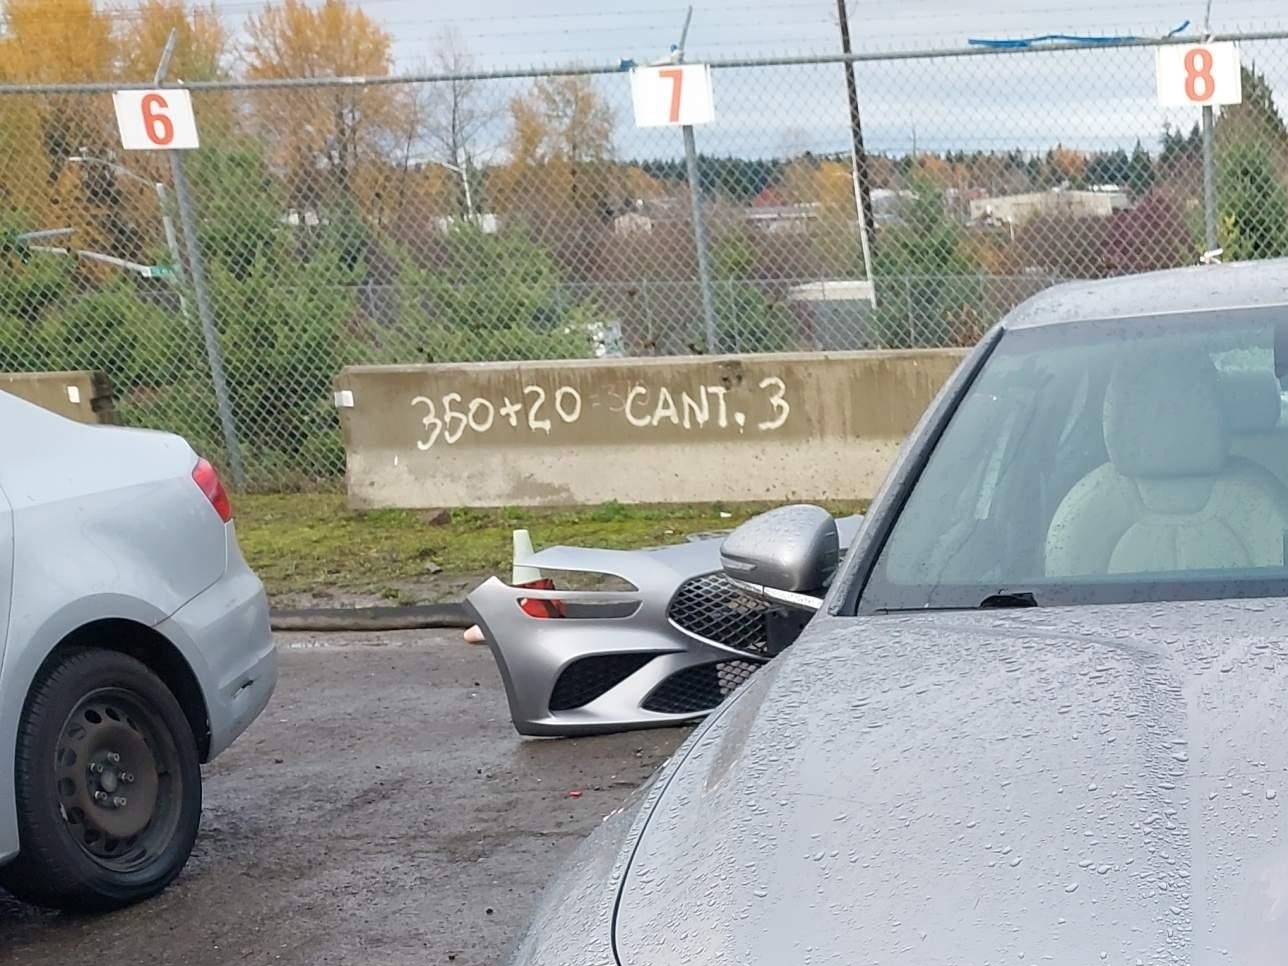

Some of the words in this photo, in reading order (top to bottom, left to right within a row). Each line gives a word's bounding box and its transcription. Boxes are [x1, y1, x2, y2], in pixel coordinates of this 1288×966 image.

[659, 70, 684, 121] 7
[1184, 48, 1215, 101] 8
[142, 93, 174, 146] 6
[624, 384, 746, 431] CANT.
[757, 376, 791, 431] 3
